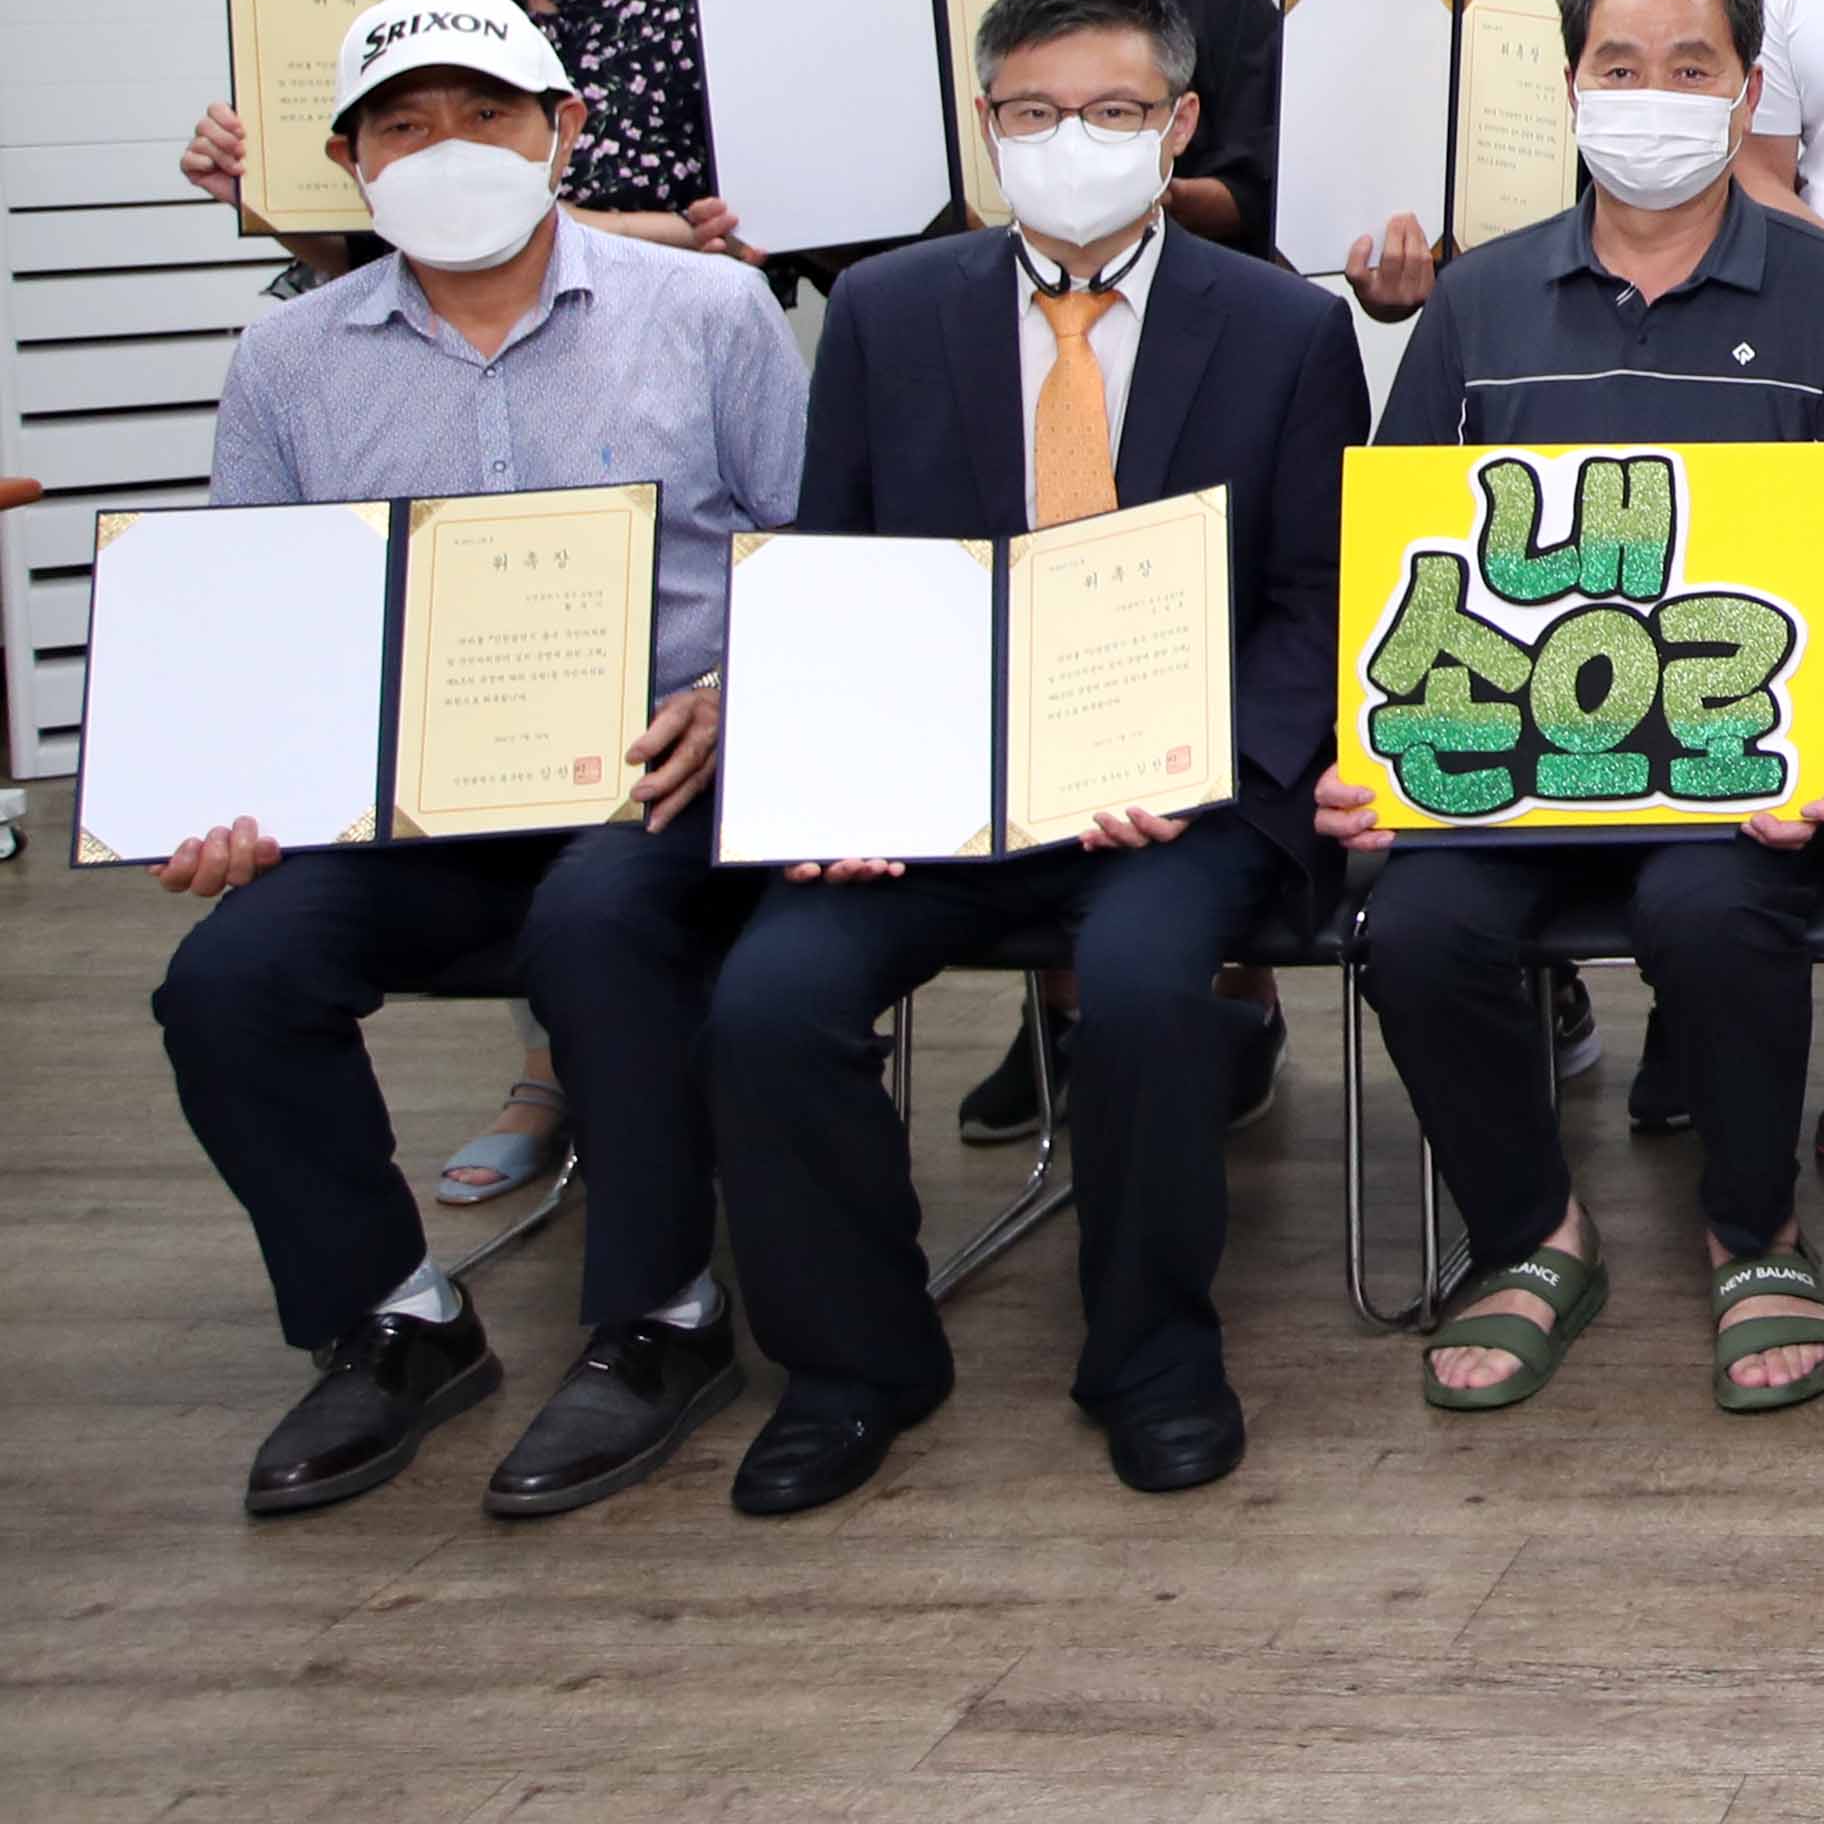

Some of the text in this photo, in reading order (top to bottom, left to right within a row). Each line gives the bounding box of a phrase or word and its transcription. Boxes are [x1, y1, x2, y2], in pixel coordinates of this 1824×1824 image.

[361, 12, 508, 75] SRIXON
[1478, 456, 1677, 606] 내
[1368, 551, 1797, 817] 손으로
[1720, 1269, 1752, 1295] NEW
